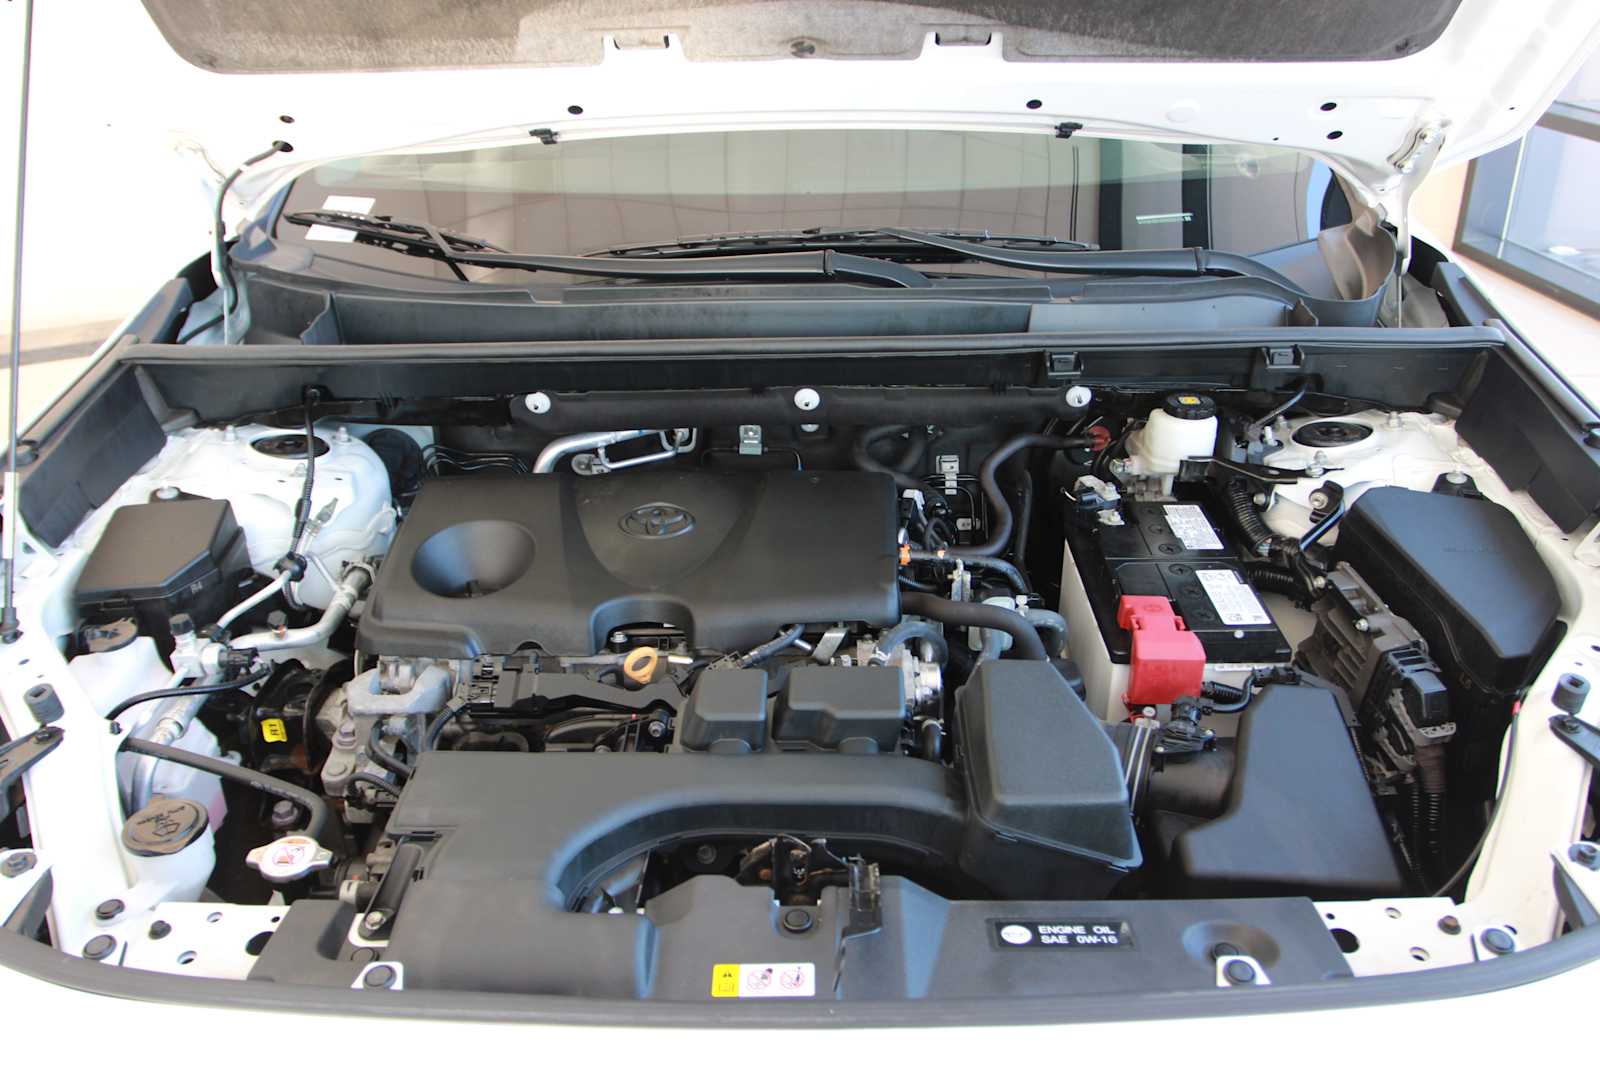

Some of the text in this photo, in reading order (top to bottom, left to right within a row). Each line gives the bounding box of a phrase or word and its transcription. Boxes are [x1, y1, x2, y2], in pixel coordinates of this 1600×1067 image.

[1038, 925, 1116, 934] ENGINE OIL
[1040, 935, 1118, 944] SAE 0W-16
